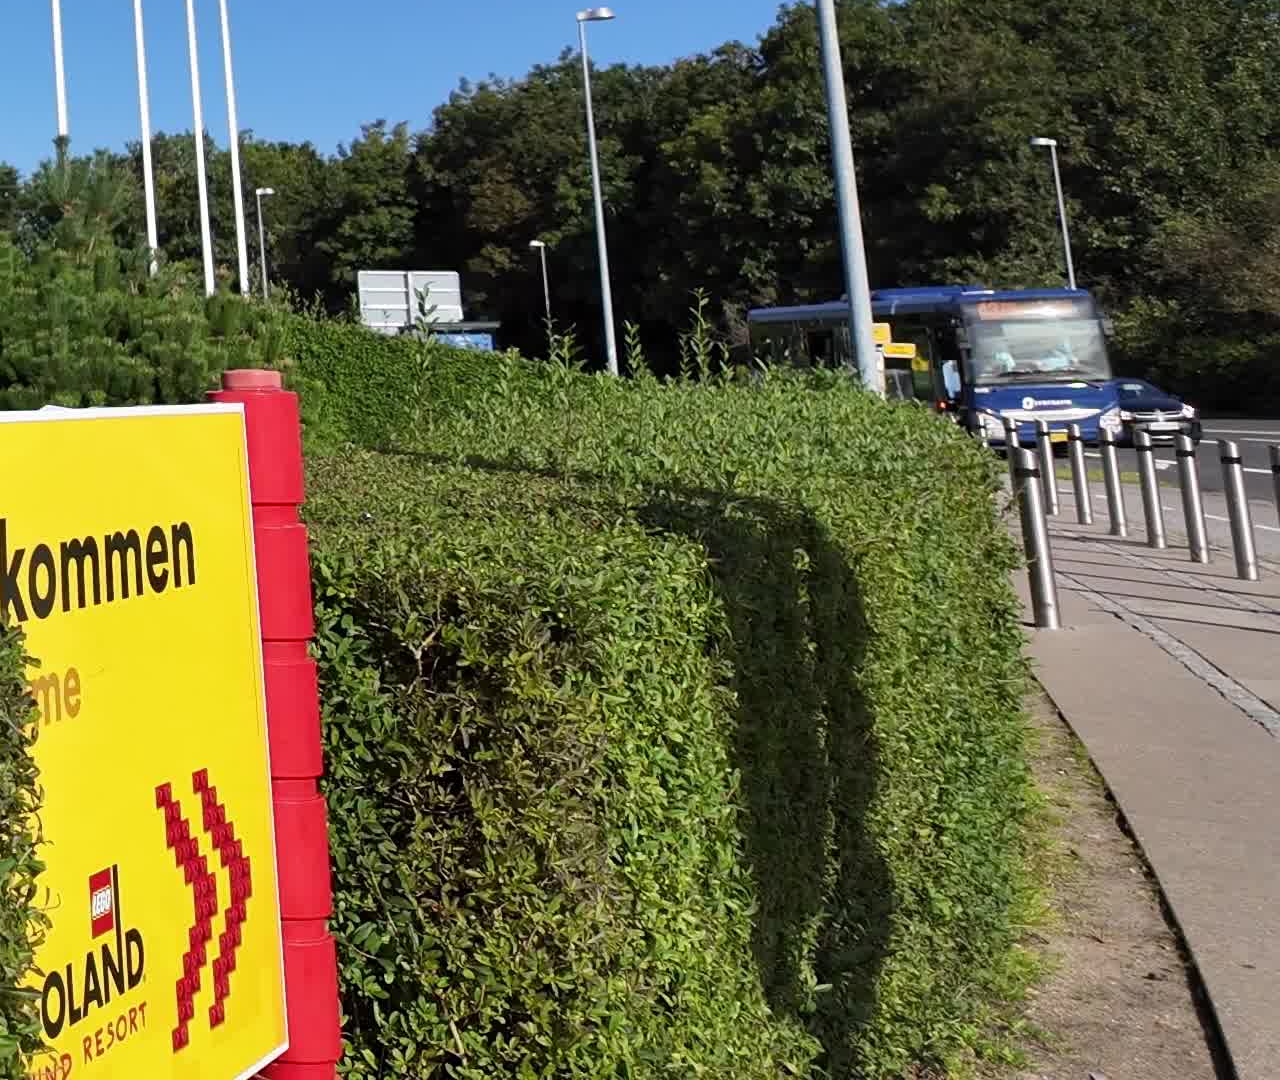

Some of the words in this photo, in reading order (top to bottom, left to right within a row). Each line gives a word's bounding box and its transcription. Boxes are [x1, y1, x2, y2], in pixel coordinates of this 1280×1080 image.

[91, 885, 113, 920] LEGO
[41, 863, 145, 1039] OLAND
[82, 1001, 147, 1065] RESORT
